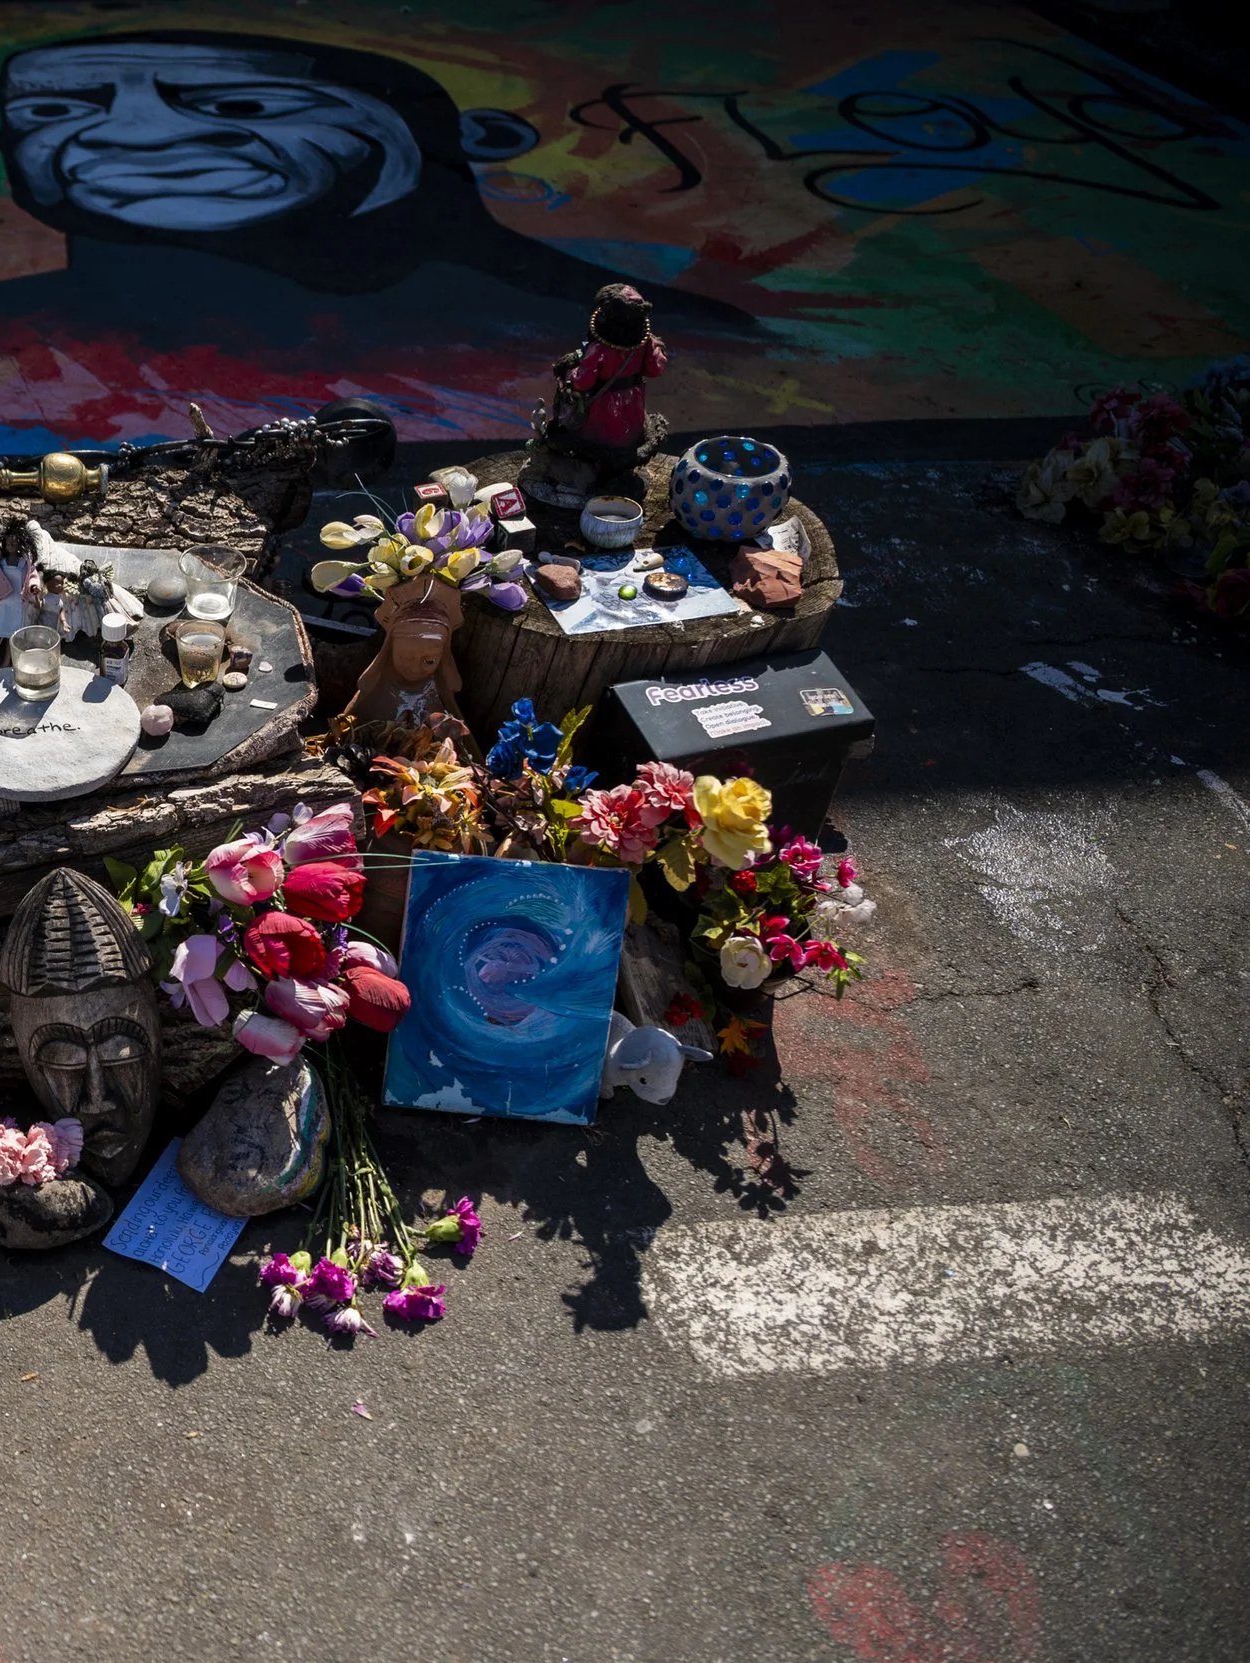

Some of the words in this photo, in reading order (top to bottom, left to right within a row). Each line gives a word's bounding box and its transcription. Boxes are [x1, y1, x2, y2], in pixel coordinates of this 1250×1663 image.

[700, 713, 724, 722] Create
[705, 720, 725, 729] Open
[163, 1196, 183, 1215] you
[110, 1205, 158, 1250] Sending
[144, 1187, 163, 1207] our
[167, 1219, 212, 1273] GEORGE
